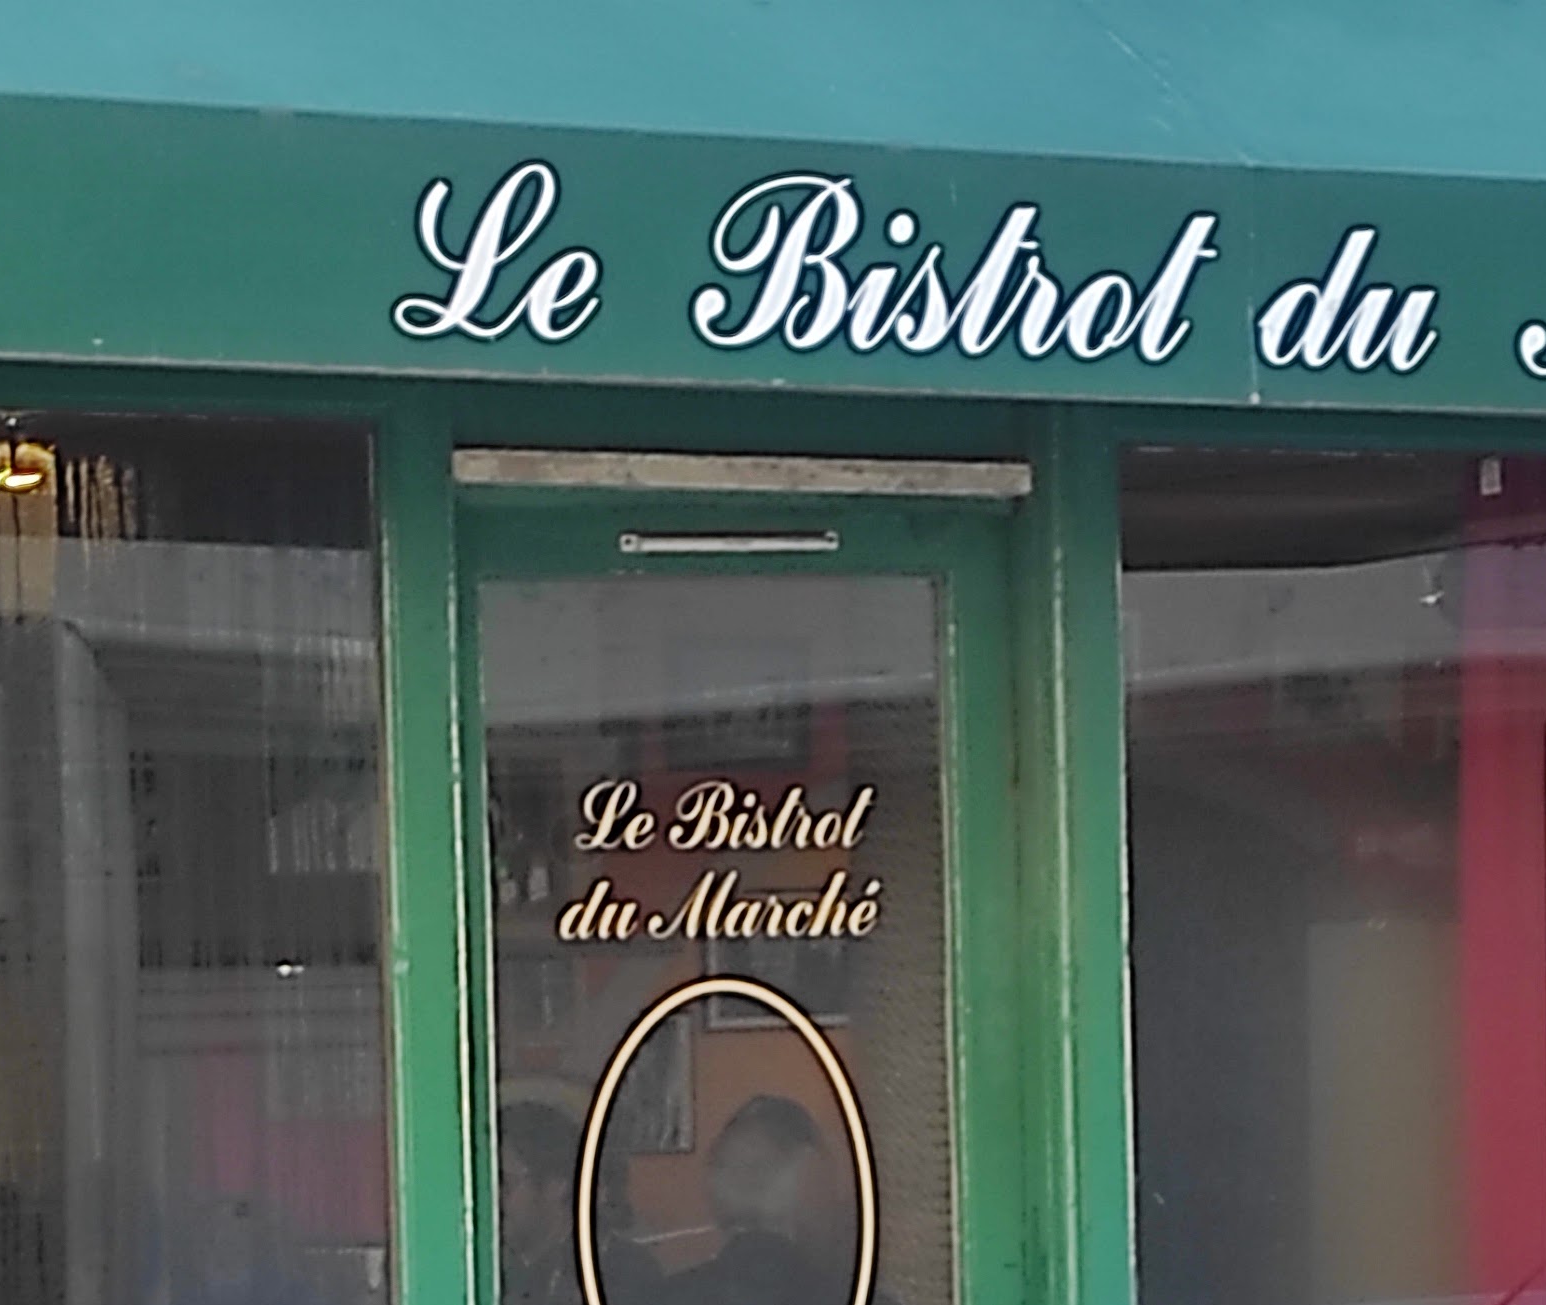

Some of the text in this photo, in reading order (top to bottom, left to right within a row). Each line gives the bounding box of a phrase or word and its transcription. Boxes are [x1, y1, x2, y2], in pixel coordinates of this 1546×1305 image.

[392, 161, 600, 340] Le
[692, 173, 1217, 362] Bistrot
[1258, 227, 1436, 373] du
[575, 780, 873, 850] Le Bistrot
[558, 870, 881, 940] du Marché
